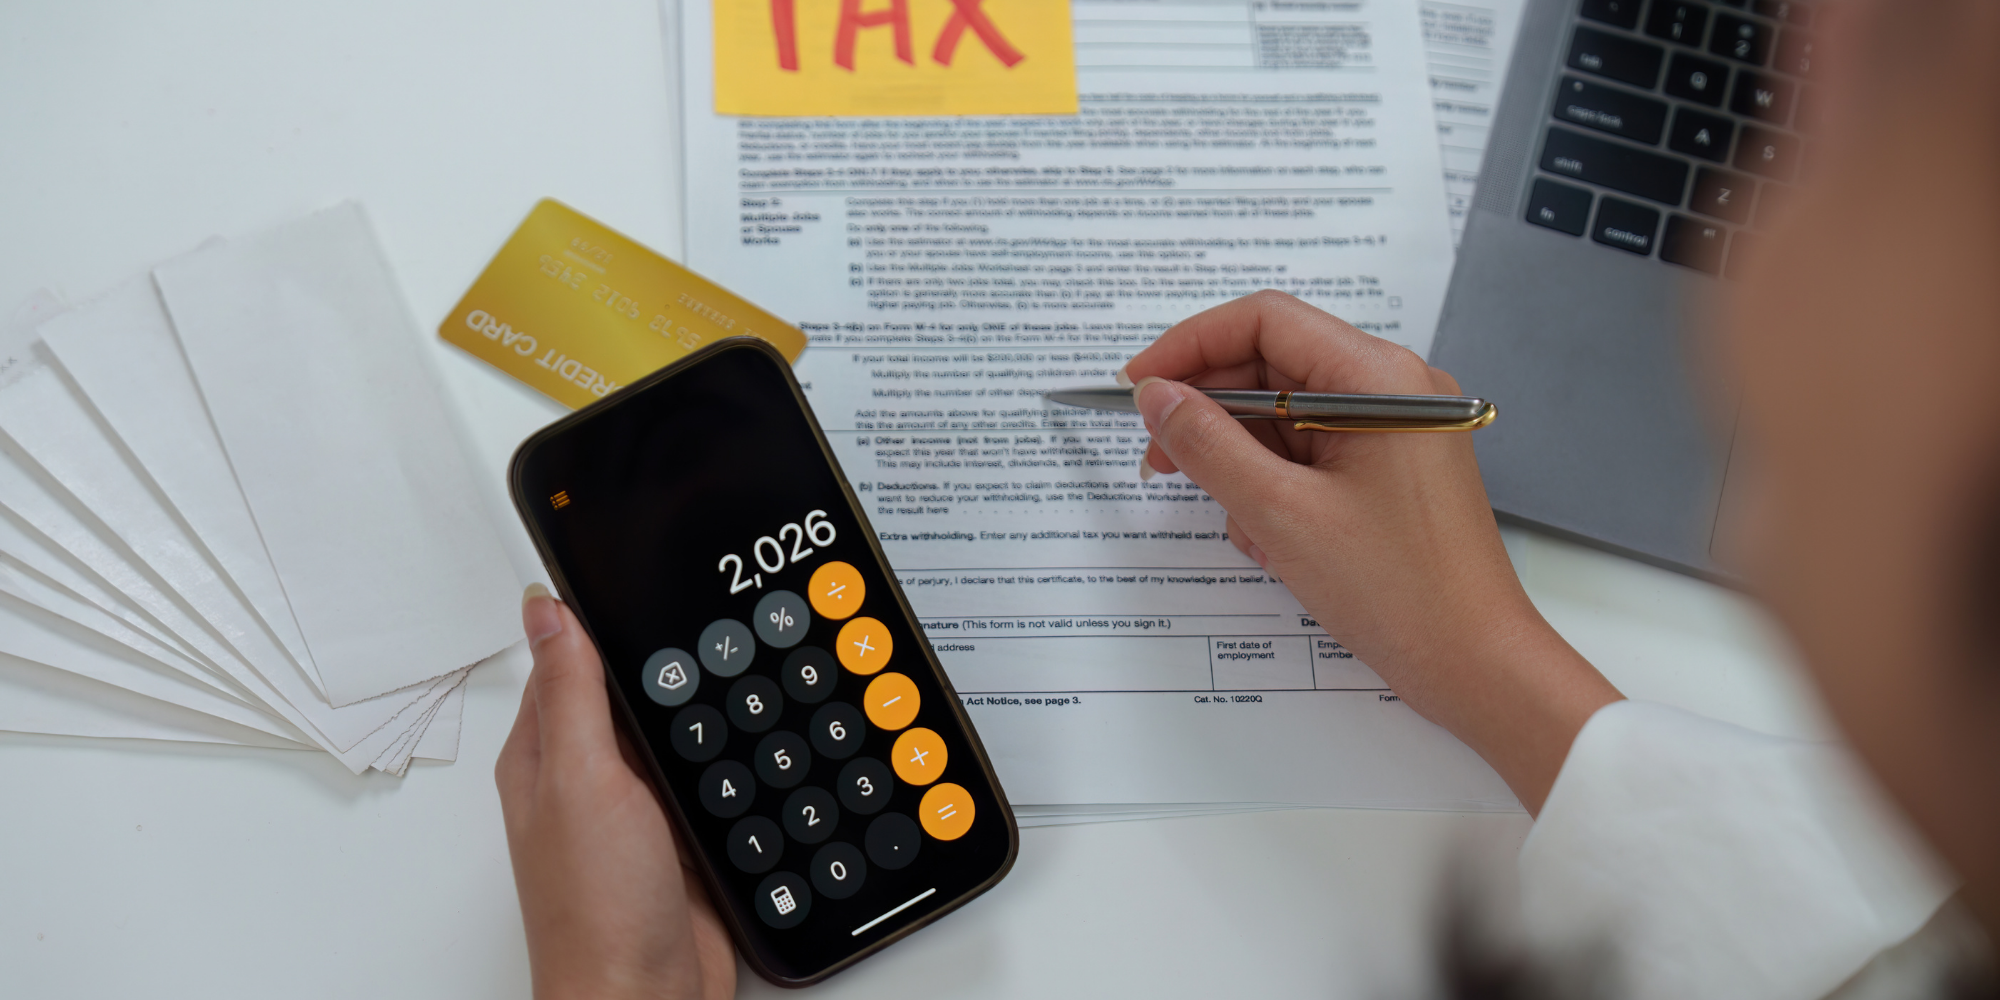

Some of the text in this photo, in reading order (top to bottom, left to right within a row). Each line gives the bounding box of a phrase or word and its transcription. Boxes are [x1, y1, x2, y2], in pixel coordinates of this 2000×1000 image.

[1755, 89, 1774, 108] W
[1566, 104, 1597, 123] caps
[1694, 128, 1711, 146] A
[1762, 145, 1776, 161] S
[1553, 155, 1583, 174] shift
[1717, 187, 1732, 206] Z
[1540, 206, 1555, 221] fn
[1604, 226, 1649, 247] control
[538, 253, 588, 291] 3456
[592, 283, 641, 320] 9012
[465, 308, 624, 397] REDIT CARD
[877, 505, 949, 514] the result here
[880, 532, 908, 540] Extra
[910, 531, 976, 541] withholding.
[979, 531, 1006, 540] Enter
[1008, 533, 1028, 541] any
[1030, 531, 1080, 539] additional
[1082, 531, 1099, 539] tax
[1101, 532, 1120, 541] you
[1122, 531, 1147, 539] want
[1149, 531, 1192, 539] withheld
[1194, 530, 1220, 539] each
[718, 509, 837, 596] 2,026
[905, 576, 915, 585] of
[917, 576, 952, 586] perjury,
[960, 576, 995, 584] declare
[996, 576, 1015, 584] that
[1017, 576, 1035, 584] this
[1036, 576, 1085, 586] certificate,
[1086, 575, 1097, 584] to
[1098, 575, 1114, 584] the
[1116, 575, 1136, 584] best
[1138, 575, 1148, 583] of
[1150, 577, 1165, 585] my
[1166, 575, 1217, 585] knowledge
[1218, 575, 1237, 583] and
[1238, 575, 1267, 585] belief,
[769, 606, 794, 632] %
[962, 620, 987, 630] (This
[989, 620, 1014, 628] form
[1016, 620, 1026, 628] is
[1028, 620, 1046, 628] not
[1048, 620, 1073, 628] valid
[1075, 619, 1109, 628] unless
[1111, 621, 1131, 629] you
[1133, 619, 1156, 629] sign
[1158, 619, 1172, 629] it.)
[937, 643, 975, 651] address
[1216, 640, 1272, 649] First date of
[1217, 651, 1275, 661] employment
[1319, 650, 1353, 659] number
[800, 665, 818, 686] 9
[746, 694, 764, 715] 8
[966, 697, 984, 705] Act
[986, 697, 1022, 707] Notice,
[1044, 698, 1070, 706] page
[1072, 696, 1082, 704] 3.
[1193, 695, 1263, 703] Cat. No. 10220Q
[1379, 694, 1400, 702] Form
[689, 721, 704, 744] 7
[829, 720, 846, 741] 6
[773, 748, 792, 770] 5
[910, 746, 929, 767] +
[721, 778, 737, 798] 4
[856, 776, 874, 796] 3
[802, 805, 821, 827] 2
[937, 803, 957, 821] =
[748, 835, 763, 854] 1
[830, 861, 847, 881] 0
